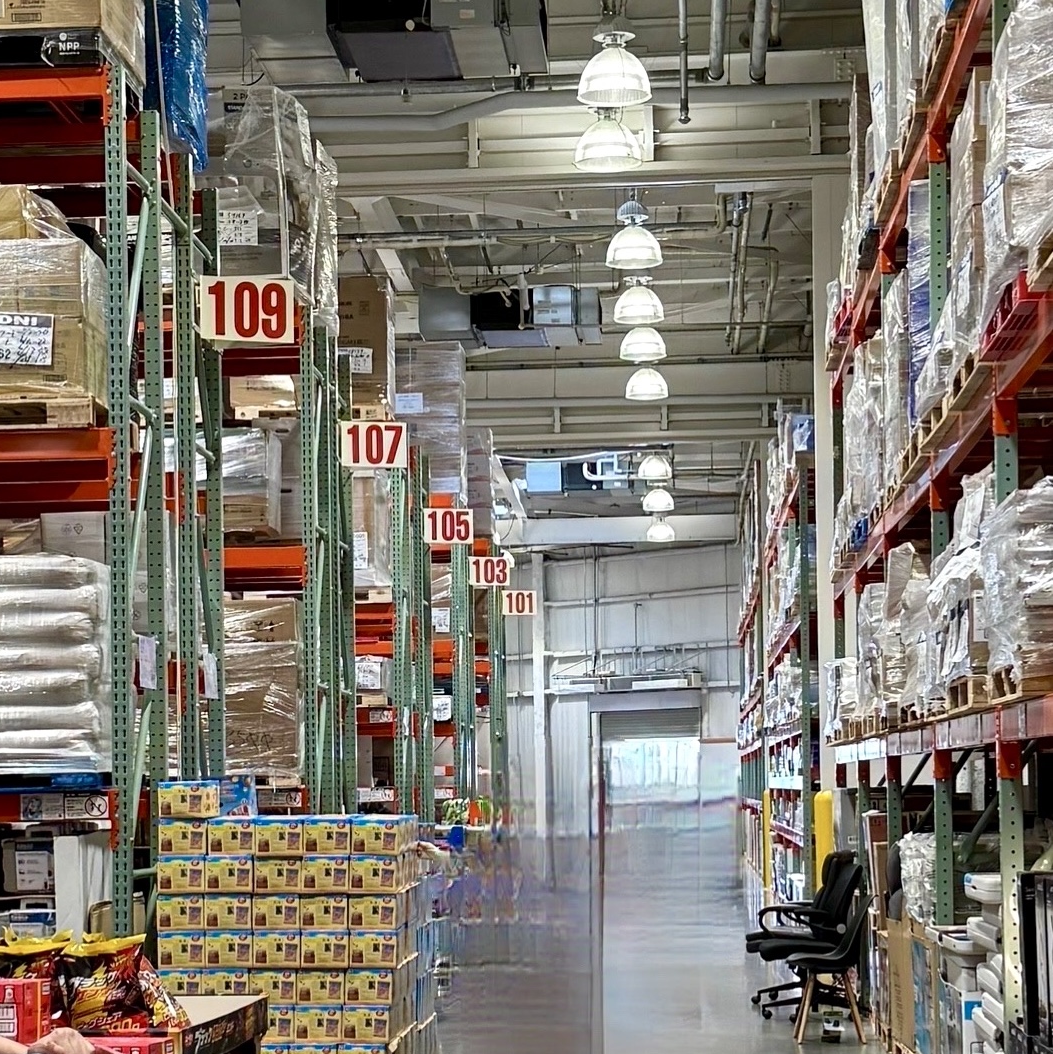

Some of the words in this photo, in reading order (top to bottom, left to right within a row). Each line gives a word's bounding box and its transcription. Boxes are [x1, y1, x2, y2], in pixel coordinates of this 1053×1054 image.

[58, 42, 80, 51] NPP
[207, 280, 287, 339] 109
[347, 424, 403, 465] 107
[427, 511, 470, 542] 105
[472, 558, 508, 584] 103
[505, 592, 534, 614] 101
